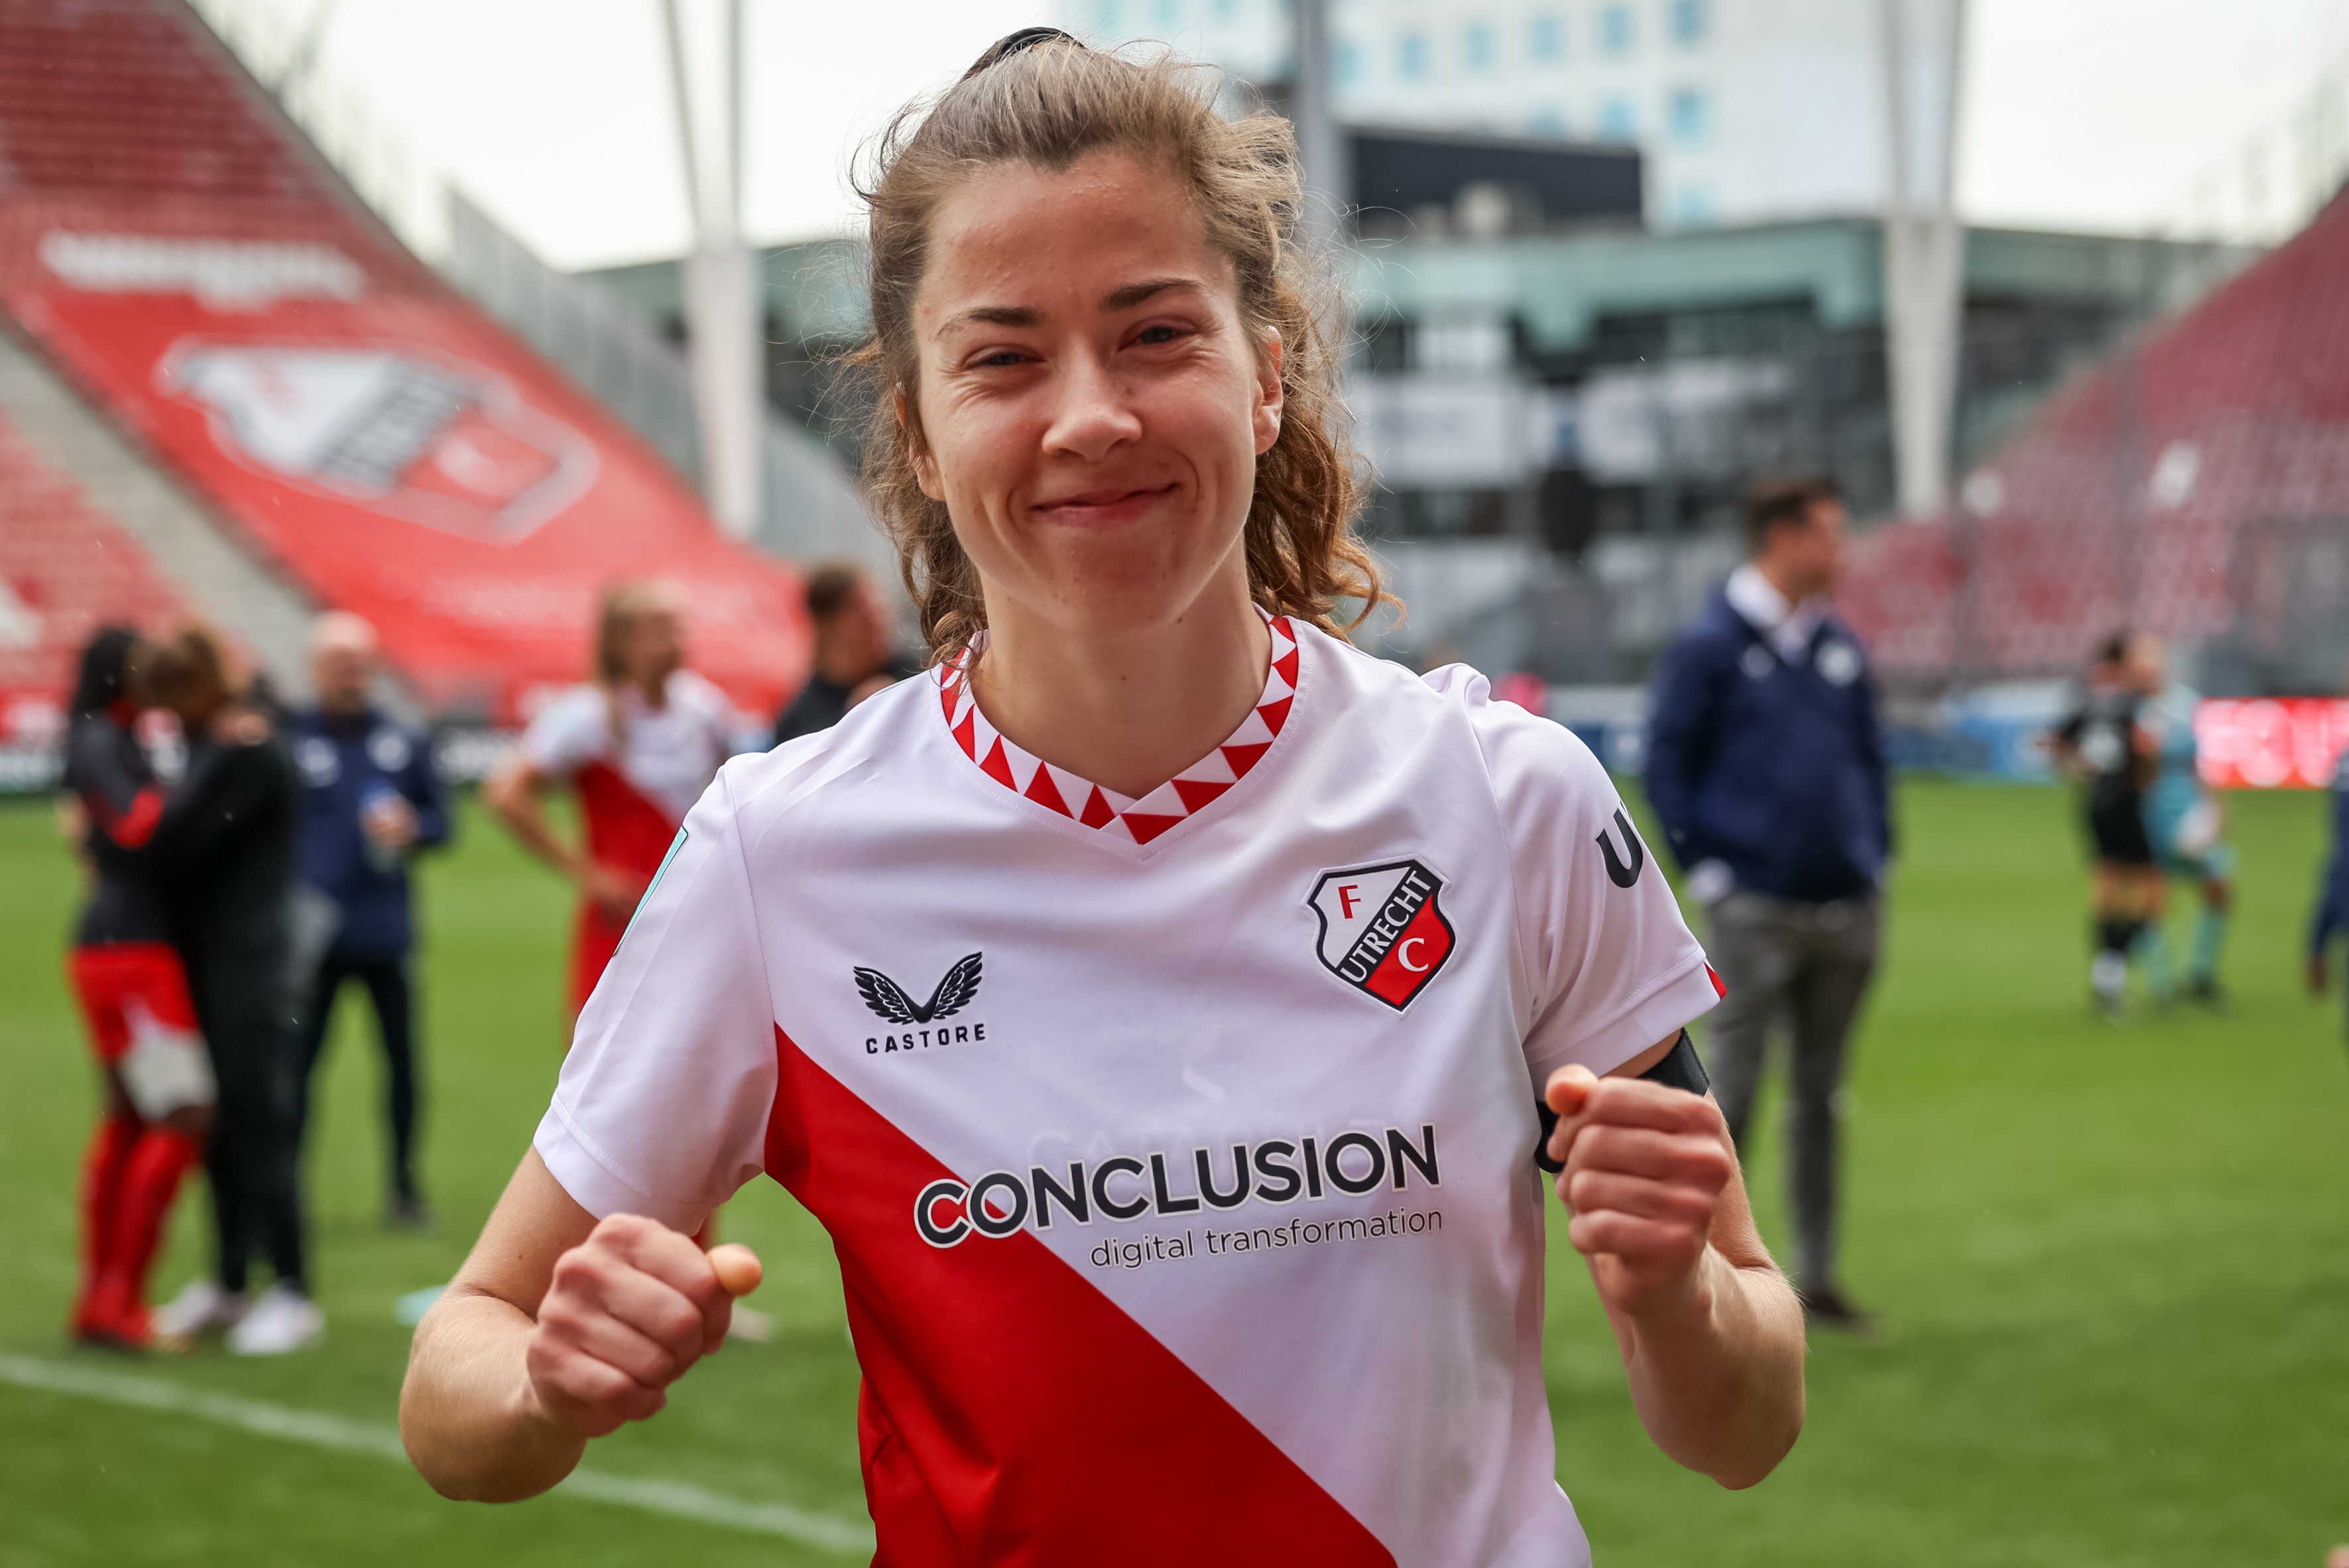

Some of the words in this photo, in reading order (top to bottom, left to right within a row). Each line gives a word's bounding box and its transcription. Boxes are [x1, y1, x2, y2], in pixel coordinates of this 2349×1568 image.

[1338, 884, 1361, 919] F
[1339, 870, 1431, 983] UTRECHT
[1398, 937, 1429, 972] C
[865, 1023, 986, 1054] CASTORE
[915, 1123, 1441, 1247] CONCLUSION
[1090, 1230, 1194, 1268] digital
[1204, 1207, 1443, 1255] transformation
